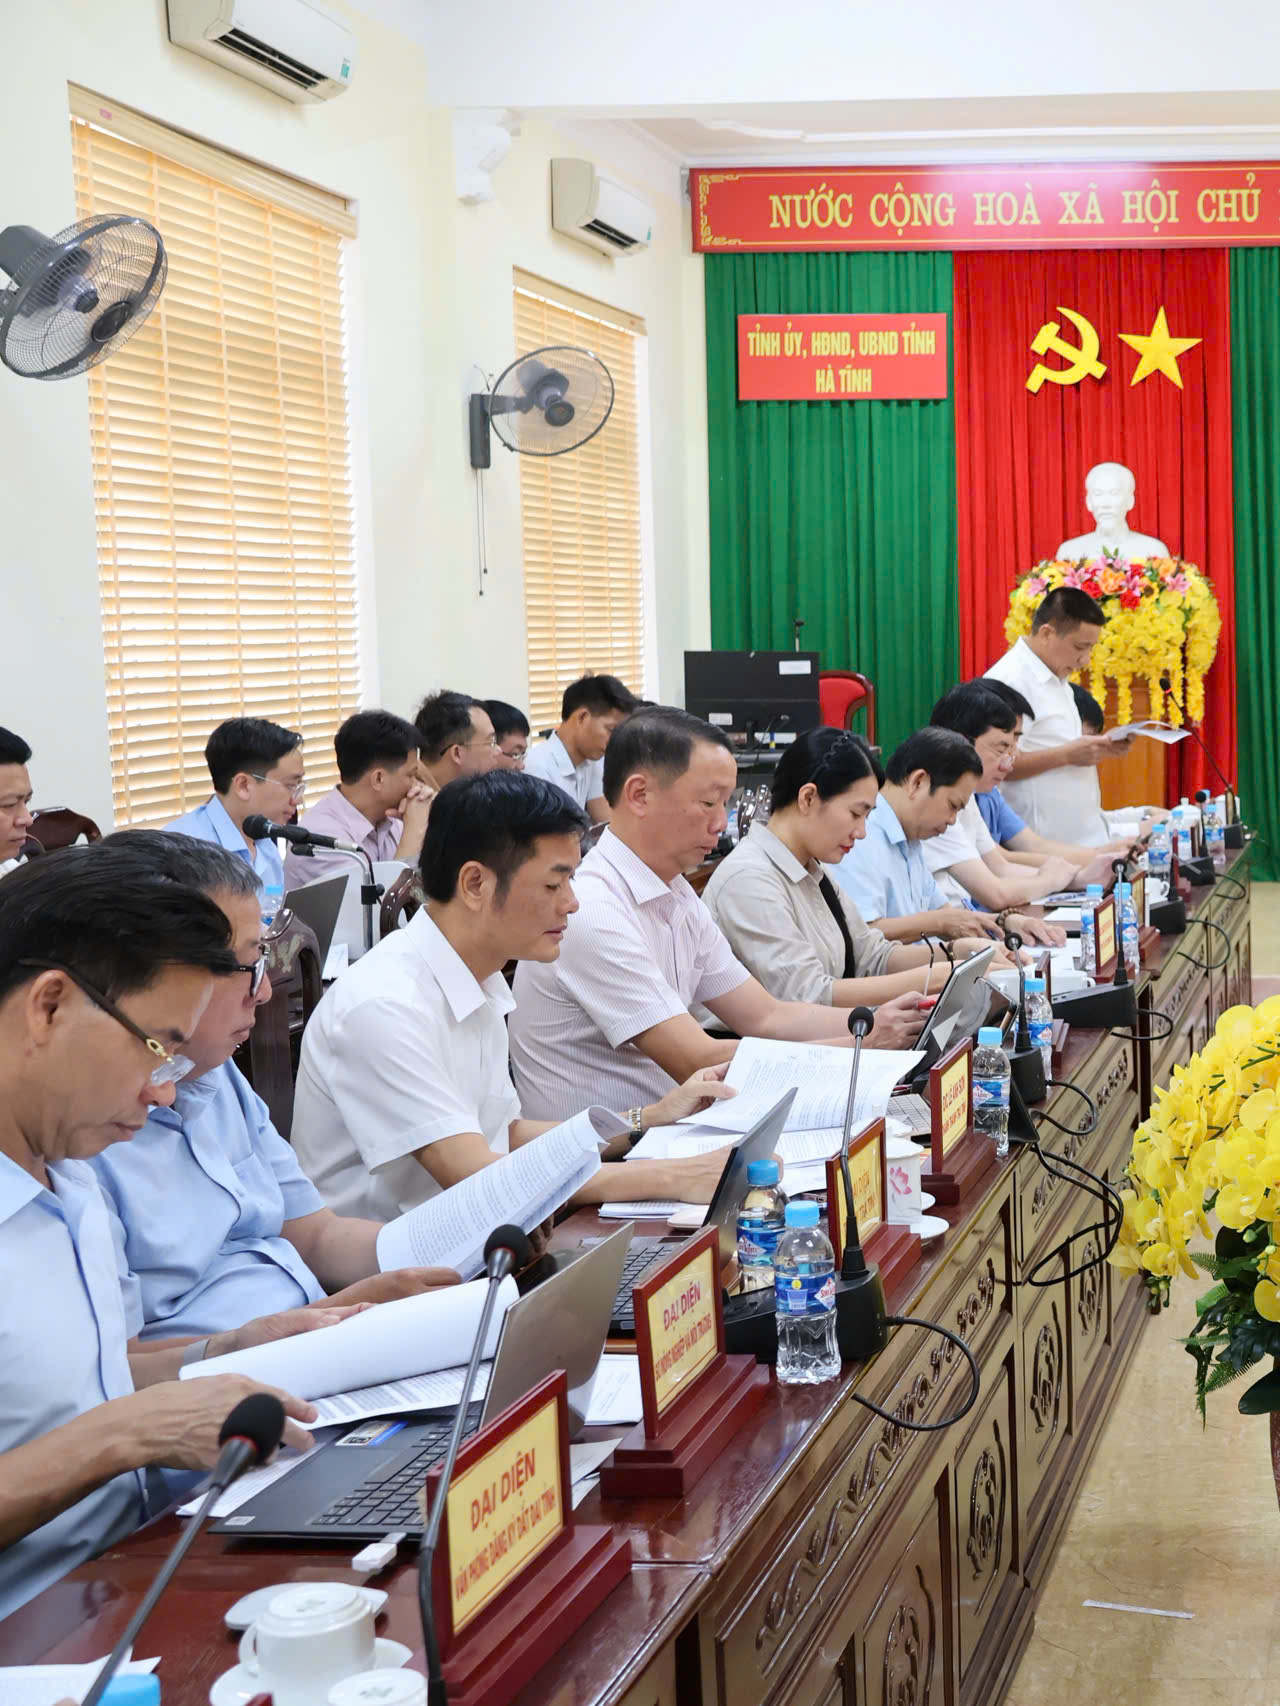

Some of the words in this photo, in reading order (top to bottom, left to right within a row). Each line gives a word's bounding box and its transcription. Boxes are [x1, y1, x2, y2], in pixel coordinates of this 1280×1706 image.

[769, 184, 853, 228] NƯỚC
[869, 182, 956, 236] CỘNG
[973, 181, 1040, 225] HOÀ
[1058, 182, 1103, 225] XÃ
[1121, 179, 1180, 233] HỘI
[1196, 172, 1261, 223] CHỦ
[747, 322, 781, 357] TỈNH
[783, 322, 807, 359] ỦY,
[811, 329, 855, 359] HĐND,
[859, 330, 899, 356] UBND
[902, 322, 936, 355] TỈNH
[815, 361, 836, 393] HÀ
[838, 360, 872, 393] TĨNH
[664, 1300, 679, 1332] ĐẠI
[681, 1280, 701, 1316] DIỆN
[471, 1482, 496, 1532] ĐẠI
[501, 1448, 536, 1503] DIỆN
